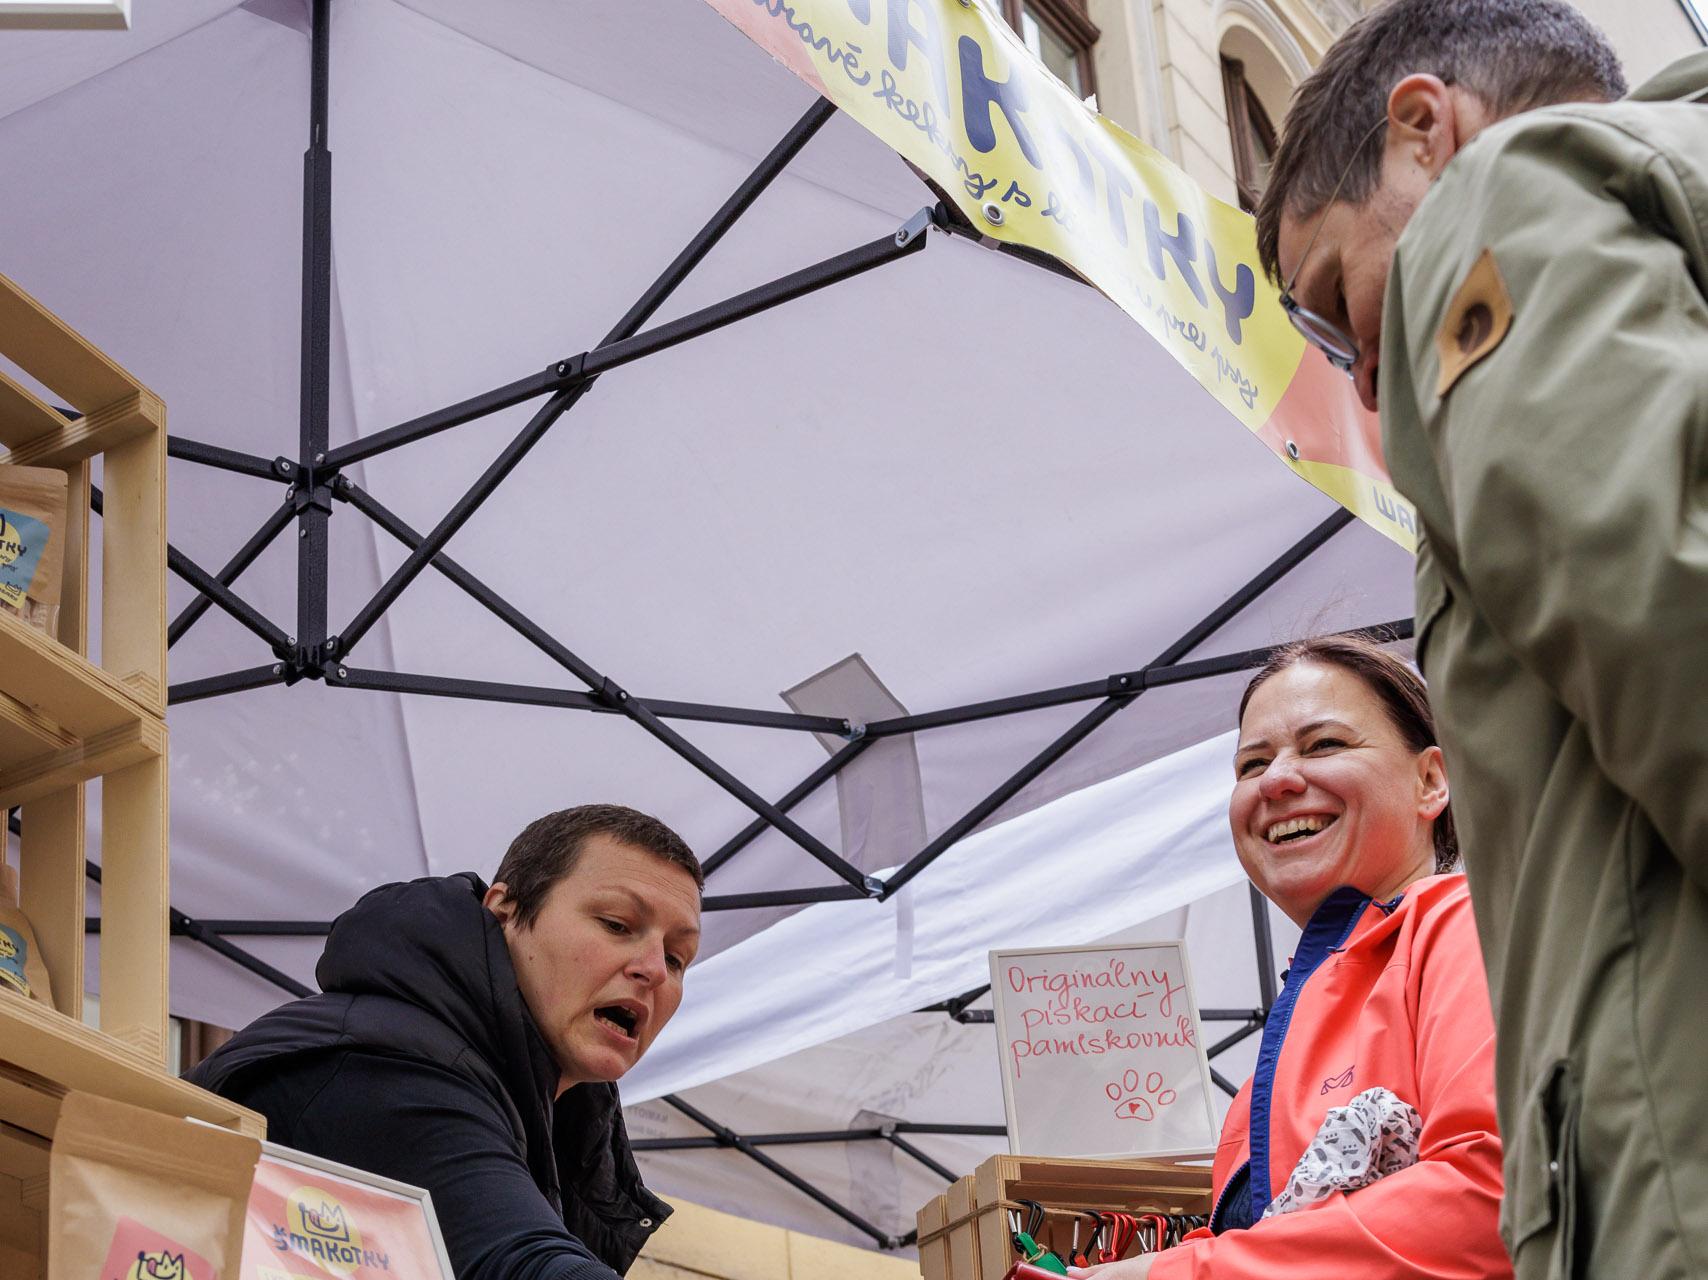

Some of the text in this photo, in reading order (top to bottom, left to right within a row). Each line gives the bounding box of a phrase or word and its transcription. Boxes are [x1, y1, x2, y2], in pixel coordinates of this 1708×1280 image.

[1373, 486, 1415, 536] WA
[1008, 958, 1186, 1018] Originálny
[272, 1223, 390, 1271] ŠMAKOTKY
